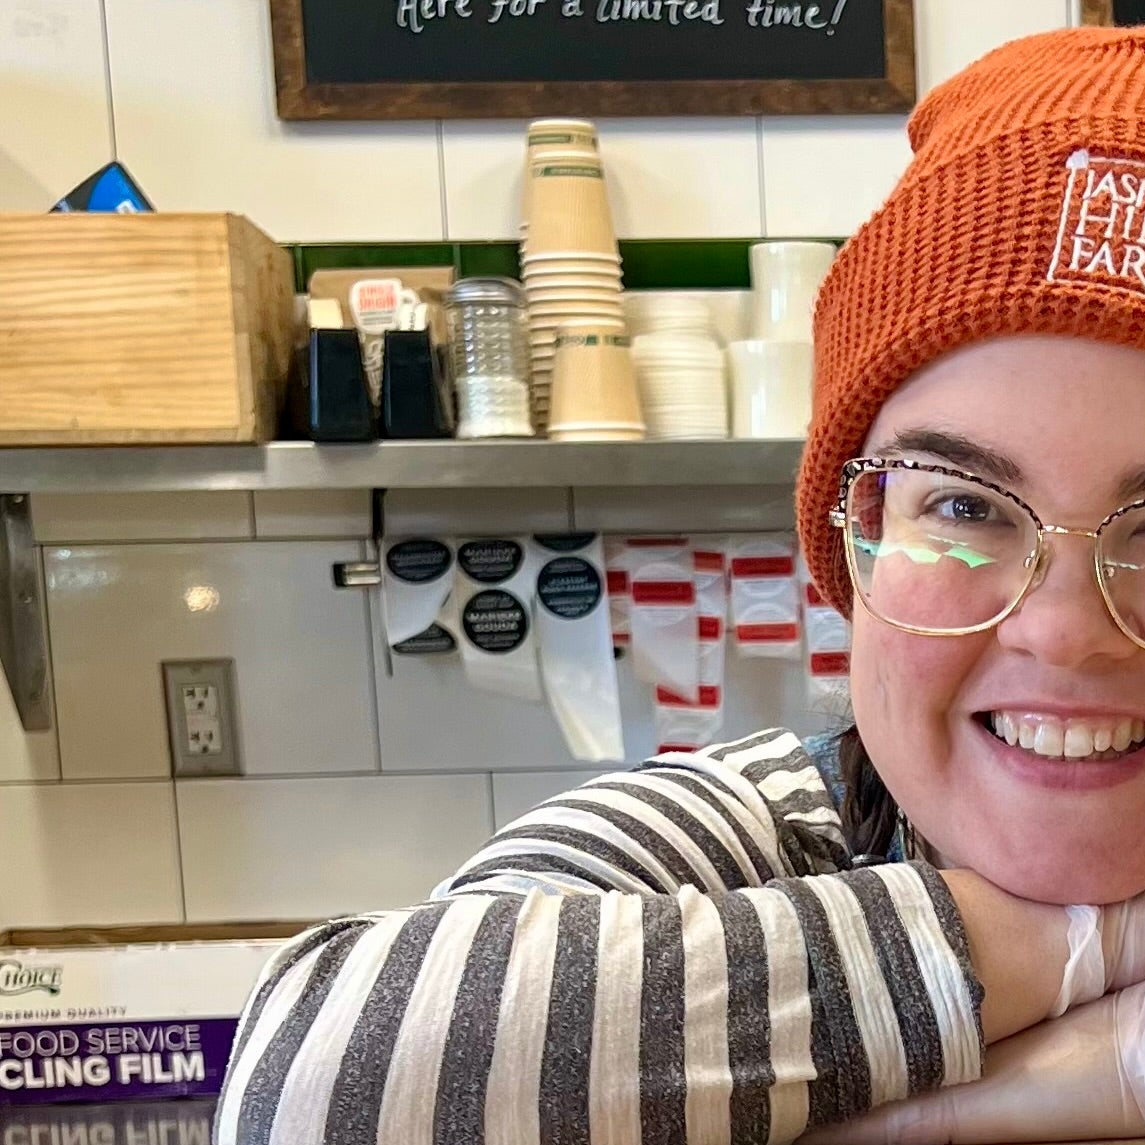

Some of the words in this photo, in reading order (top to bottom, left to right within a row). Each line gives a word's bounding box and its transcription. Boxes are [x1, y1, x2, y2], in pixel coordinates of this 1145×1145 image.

[595, 0, 726, 26] limited
[745, 0, 845, 36] time!
[87, 1024, 202, 1054] SERVICE
[0, 1055, 111, 1090] CLING
[118, 1050, 205, 1085] FILM
